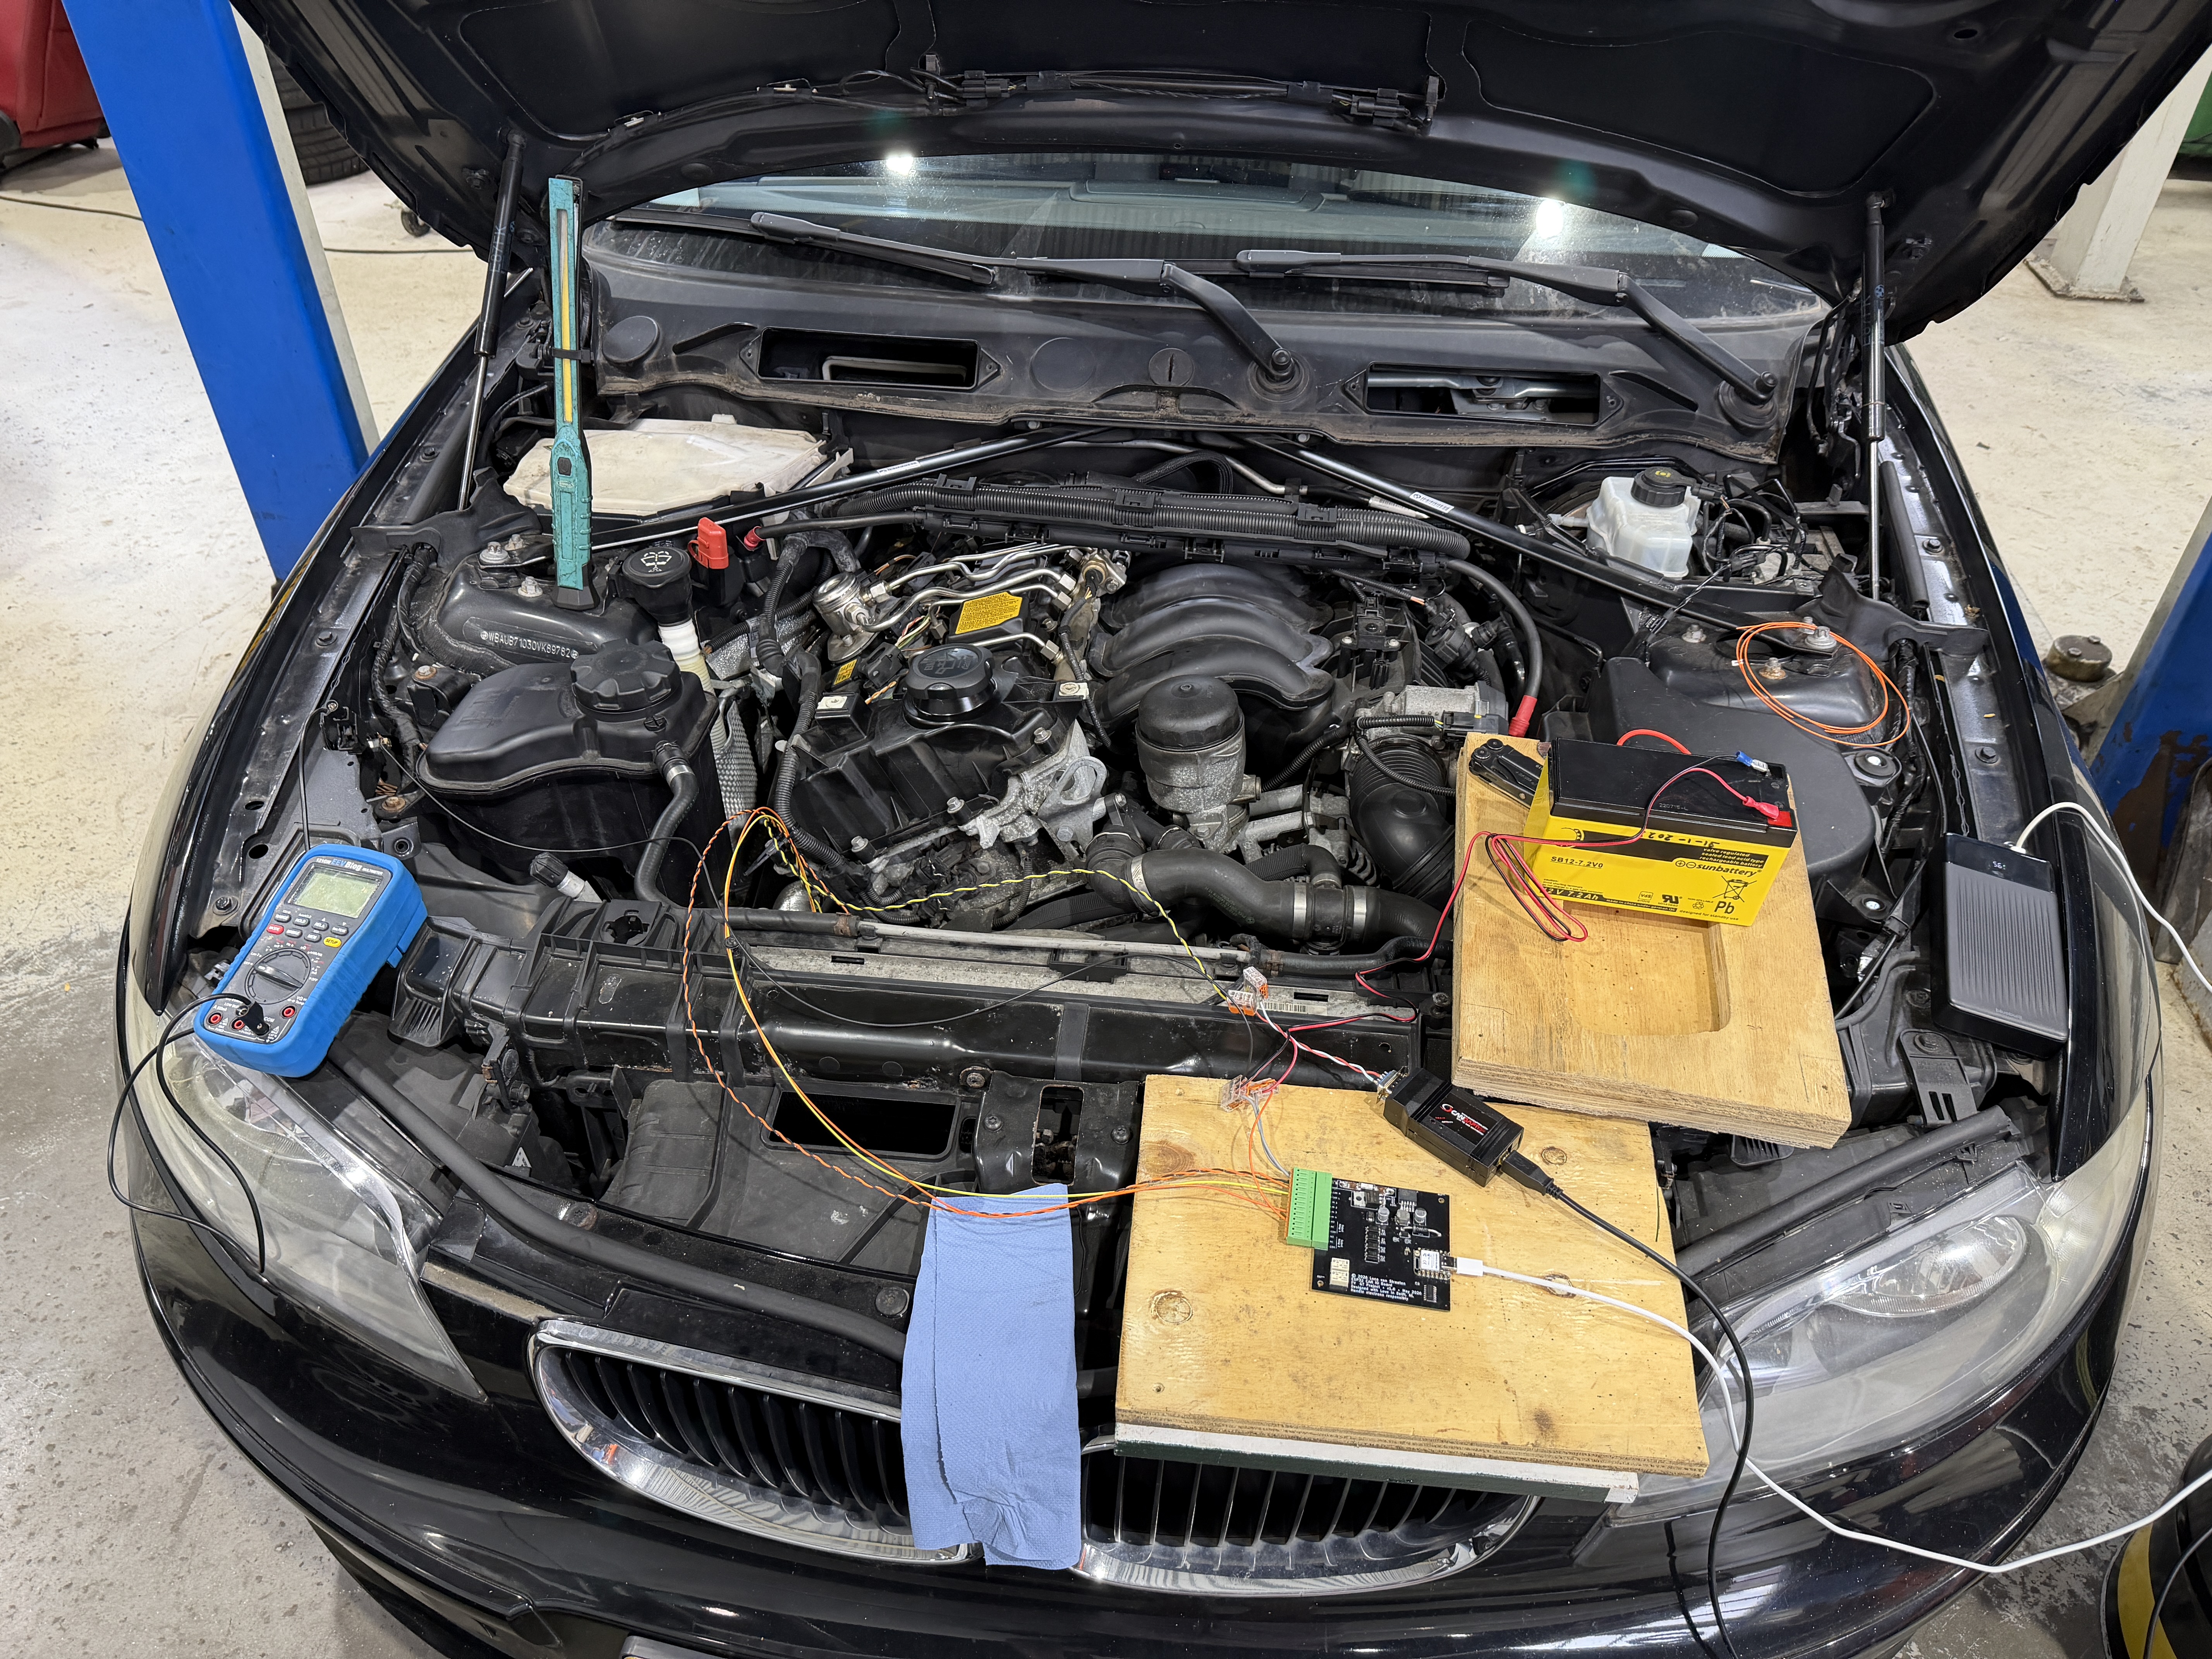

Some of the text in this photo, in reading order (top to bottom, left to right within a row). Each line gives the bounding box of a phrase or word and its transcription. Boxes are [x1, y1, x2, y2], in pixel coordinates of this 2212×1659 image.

[489, 632, 570, 658] WBAUB71030VK89782
[1551, 856, 1604, 868] SB12-7.2V0
[1699, 856, 1740, 864] rechargeable
[1714, 900, 1735, 914] Pb
